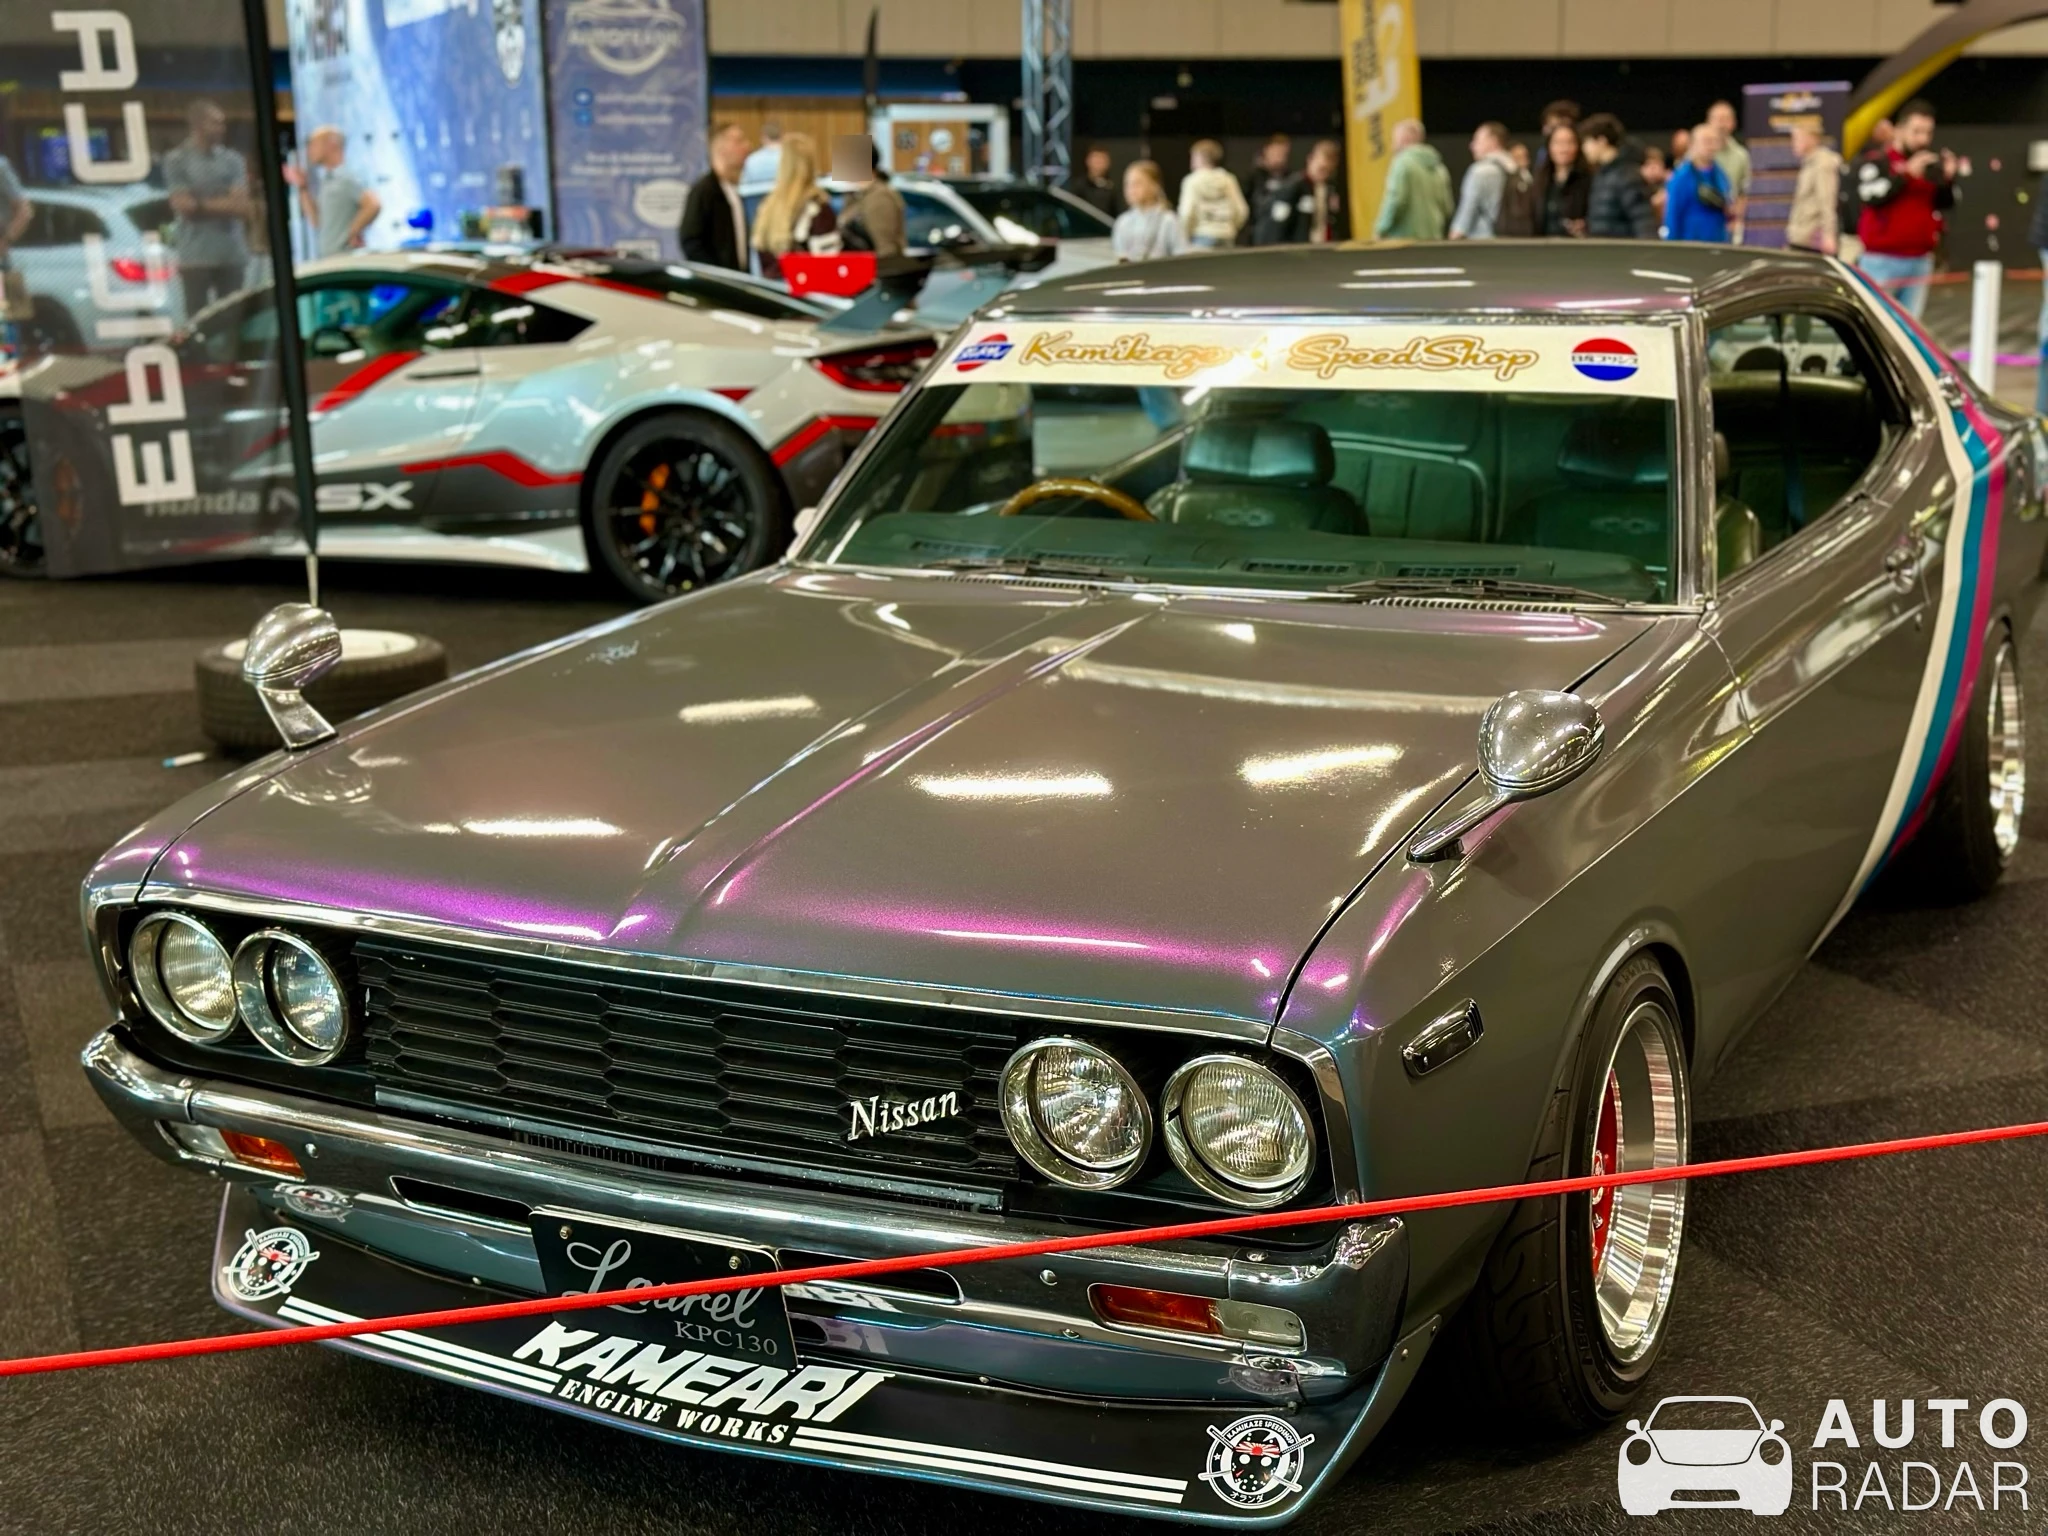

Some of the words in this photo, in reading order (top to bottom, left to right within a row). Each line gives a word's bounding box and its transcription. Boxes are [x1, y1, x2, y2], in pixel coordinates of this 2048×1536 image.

[1018, 331, 1234, 379] Kamikaze
[1286, 334, 1540, 381] SpeedShop
[848, 1091, 960, 1141] Nissan
[674, 1320, 778, 1355] KPC130
[512, 1320, 896, 1423] KAMEARI
[558, 1379, 670, 1424] ENGINE
[677, 1408, 789, 1445] WORKS
[1226, 1420, 1263, 1440] KAMIKAZE
